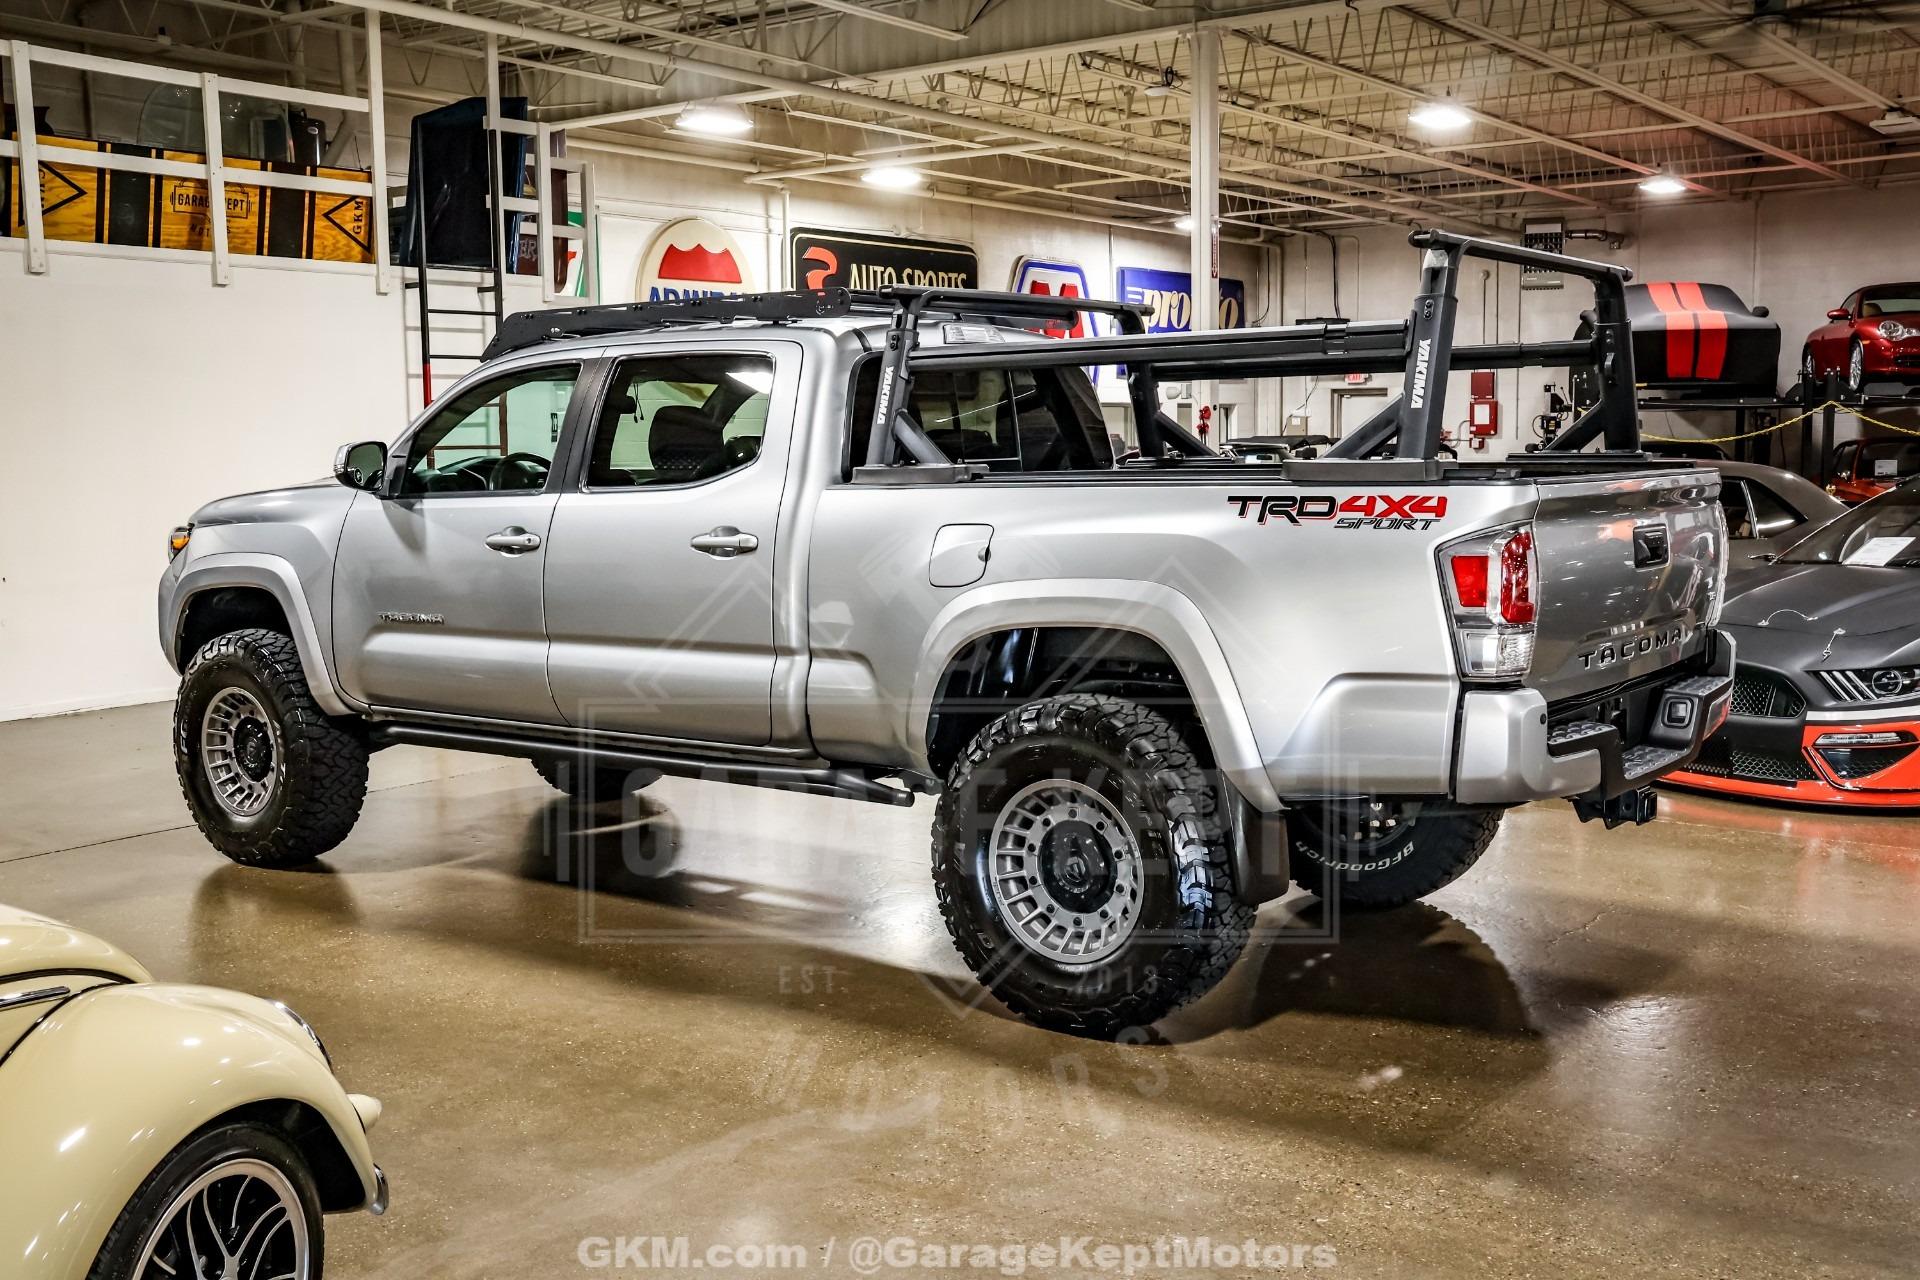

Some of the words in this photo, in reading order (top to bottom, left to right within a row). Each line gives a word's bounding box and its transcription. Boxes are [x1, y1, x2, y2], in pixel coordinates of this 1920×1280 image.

[352, 200, 364, 235] GKM
[850, 263, 897, 290] AUTO
[902, 267, 967, 289] SPORTS
[1410, 338, 1432, 409] YAKIMA
[876, 366, 894, 425] YAKIMA
[1227, 495, 1339, 526] TRD
[1338, 494, 1448, 518] 4X4
[1333, 517, 1441, 531] SPORT
[1578, 626, 1682, 670] TACOMA
[1295, 840, 1415, 871] BFGoodrich
